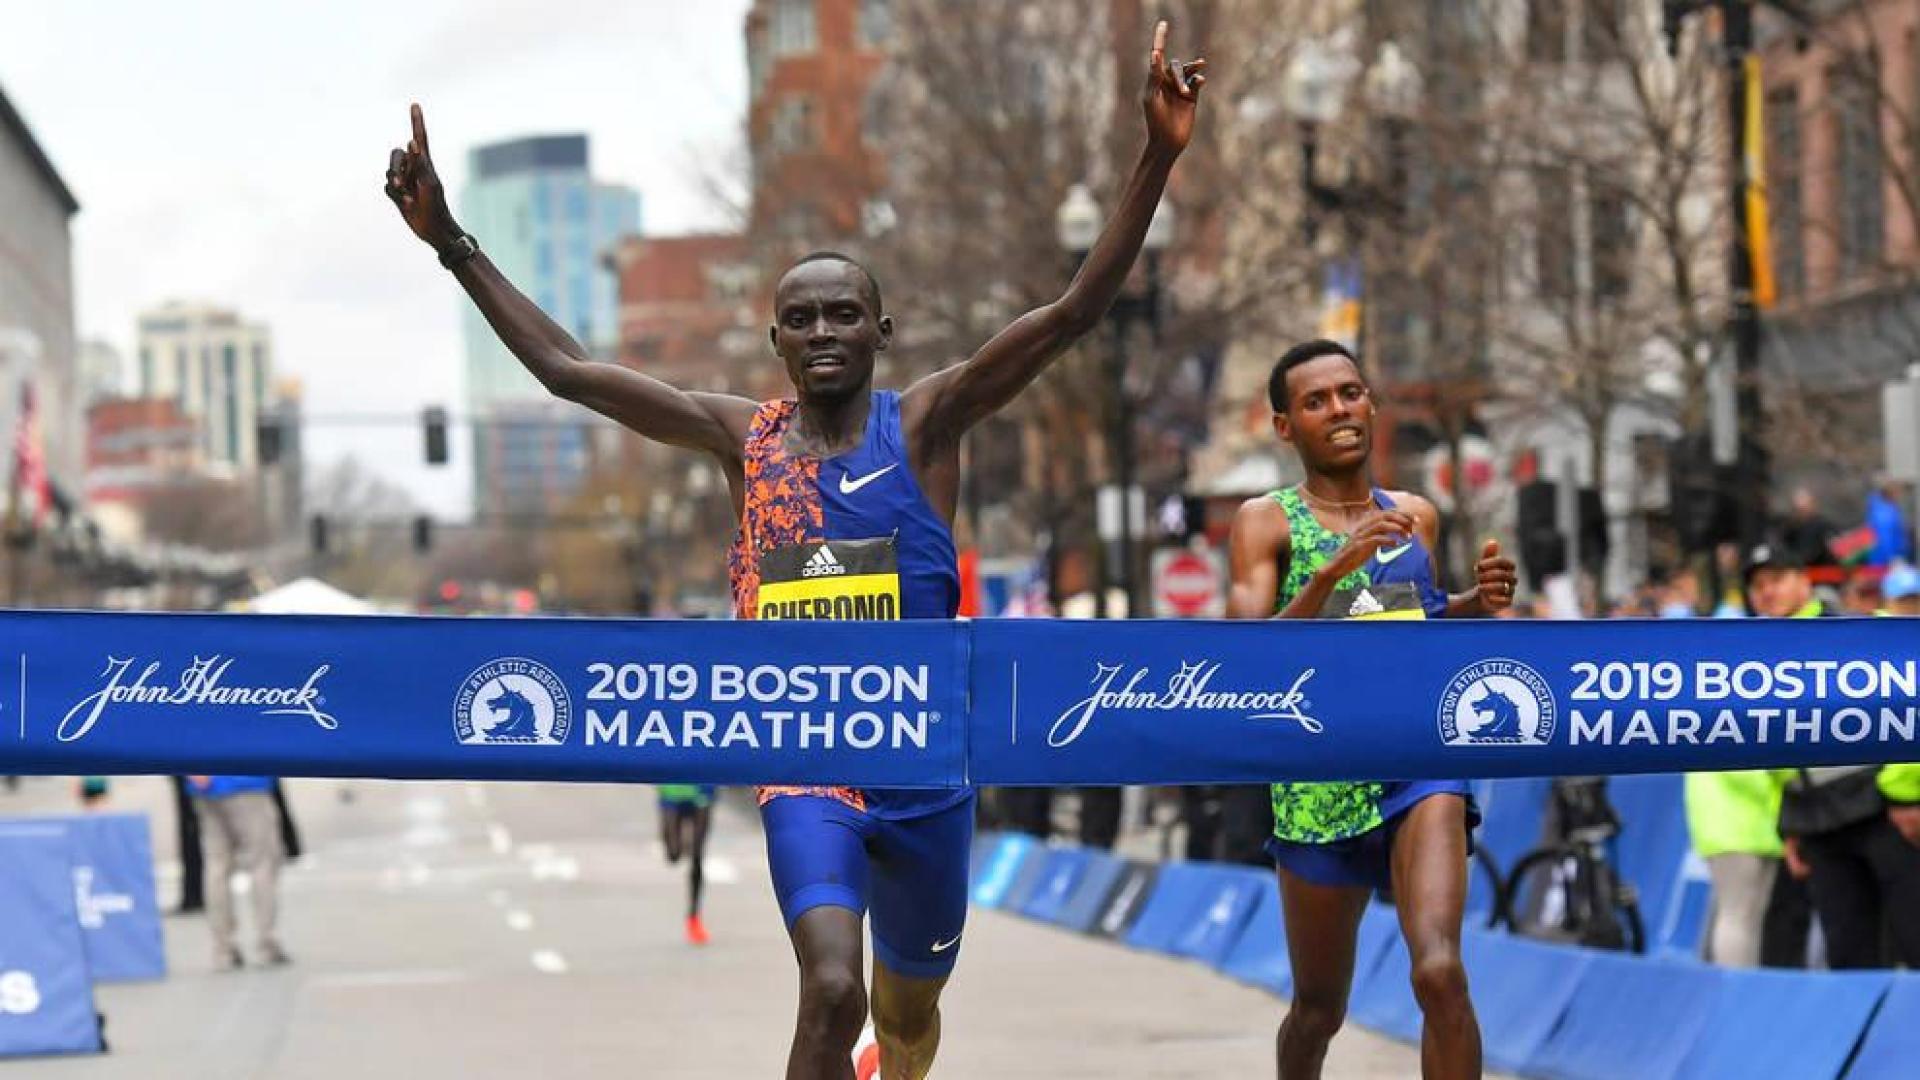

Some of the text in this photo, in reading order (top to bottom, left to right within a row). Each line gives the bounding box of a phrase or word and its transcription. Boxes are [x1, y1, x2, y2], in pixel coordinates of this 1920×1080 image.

[802, 563, 846, 576] adidas
[57, 654, 338, 742] John Hancock
[457, 661, 568, 738] BOSTON ATHLETIC ASSOCIATION
[585, 662, 928, 703] 2019 BOSTON
[1047, 659, 1324, 747] John Hancock
[1442, 691, 1459, 738] BOSTON
[1454, 662, 1512, 691] ATHLETIC
[1569, 660, 1917, 701] 2019 BOSTON
[1568, 707, 1915, 746] MARATHON
